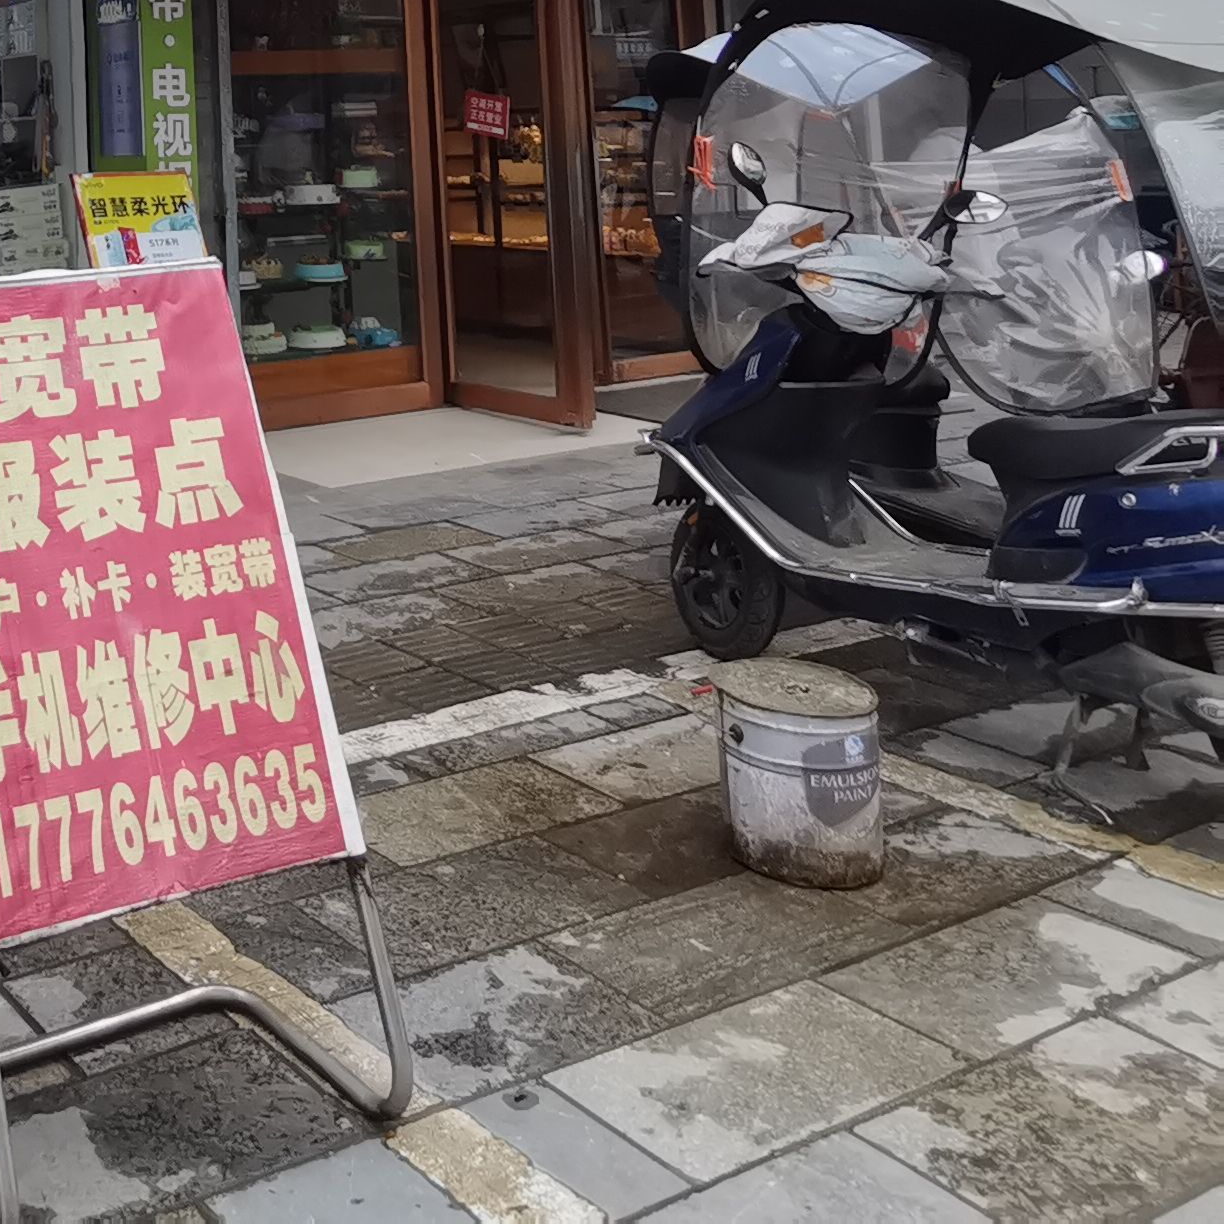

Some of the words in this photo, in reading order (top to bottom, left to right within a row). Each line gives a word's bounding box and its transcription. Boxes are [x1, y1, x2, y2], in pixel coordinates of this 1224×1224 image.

[88, 195, 190, 218] 智慧柔光环
[834, 785, 872, 804] PAINT
